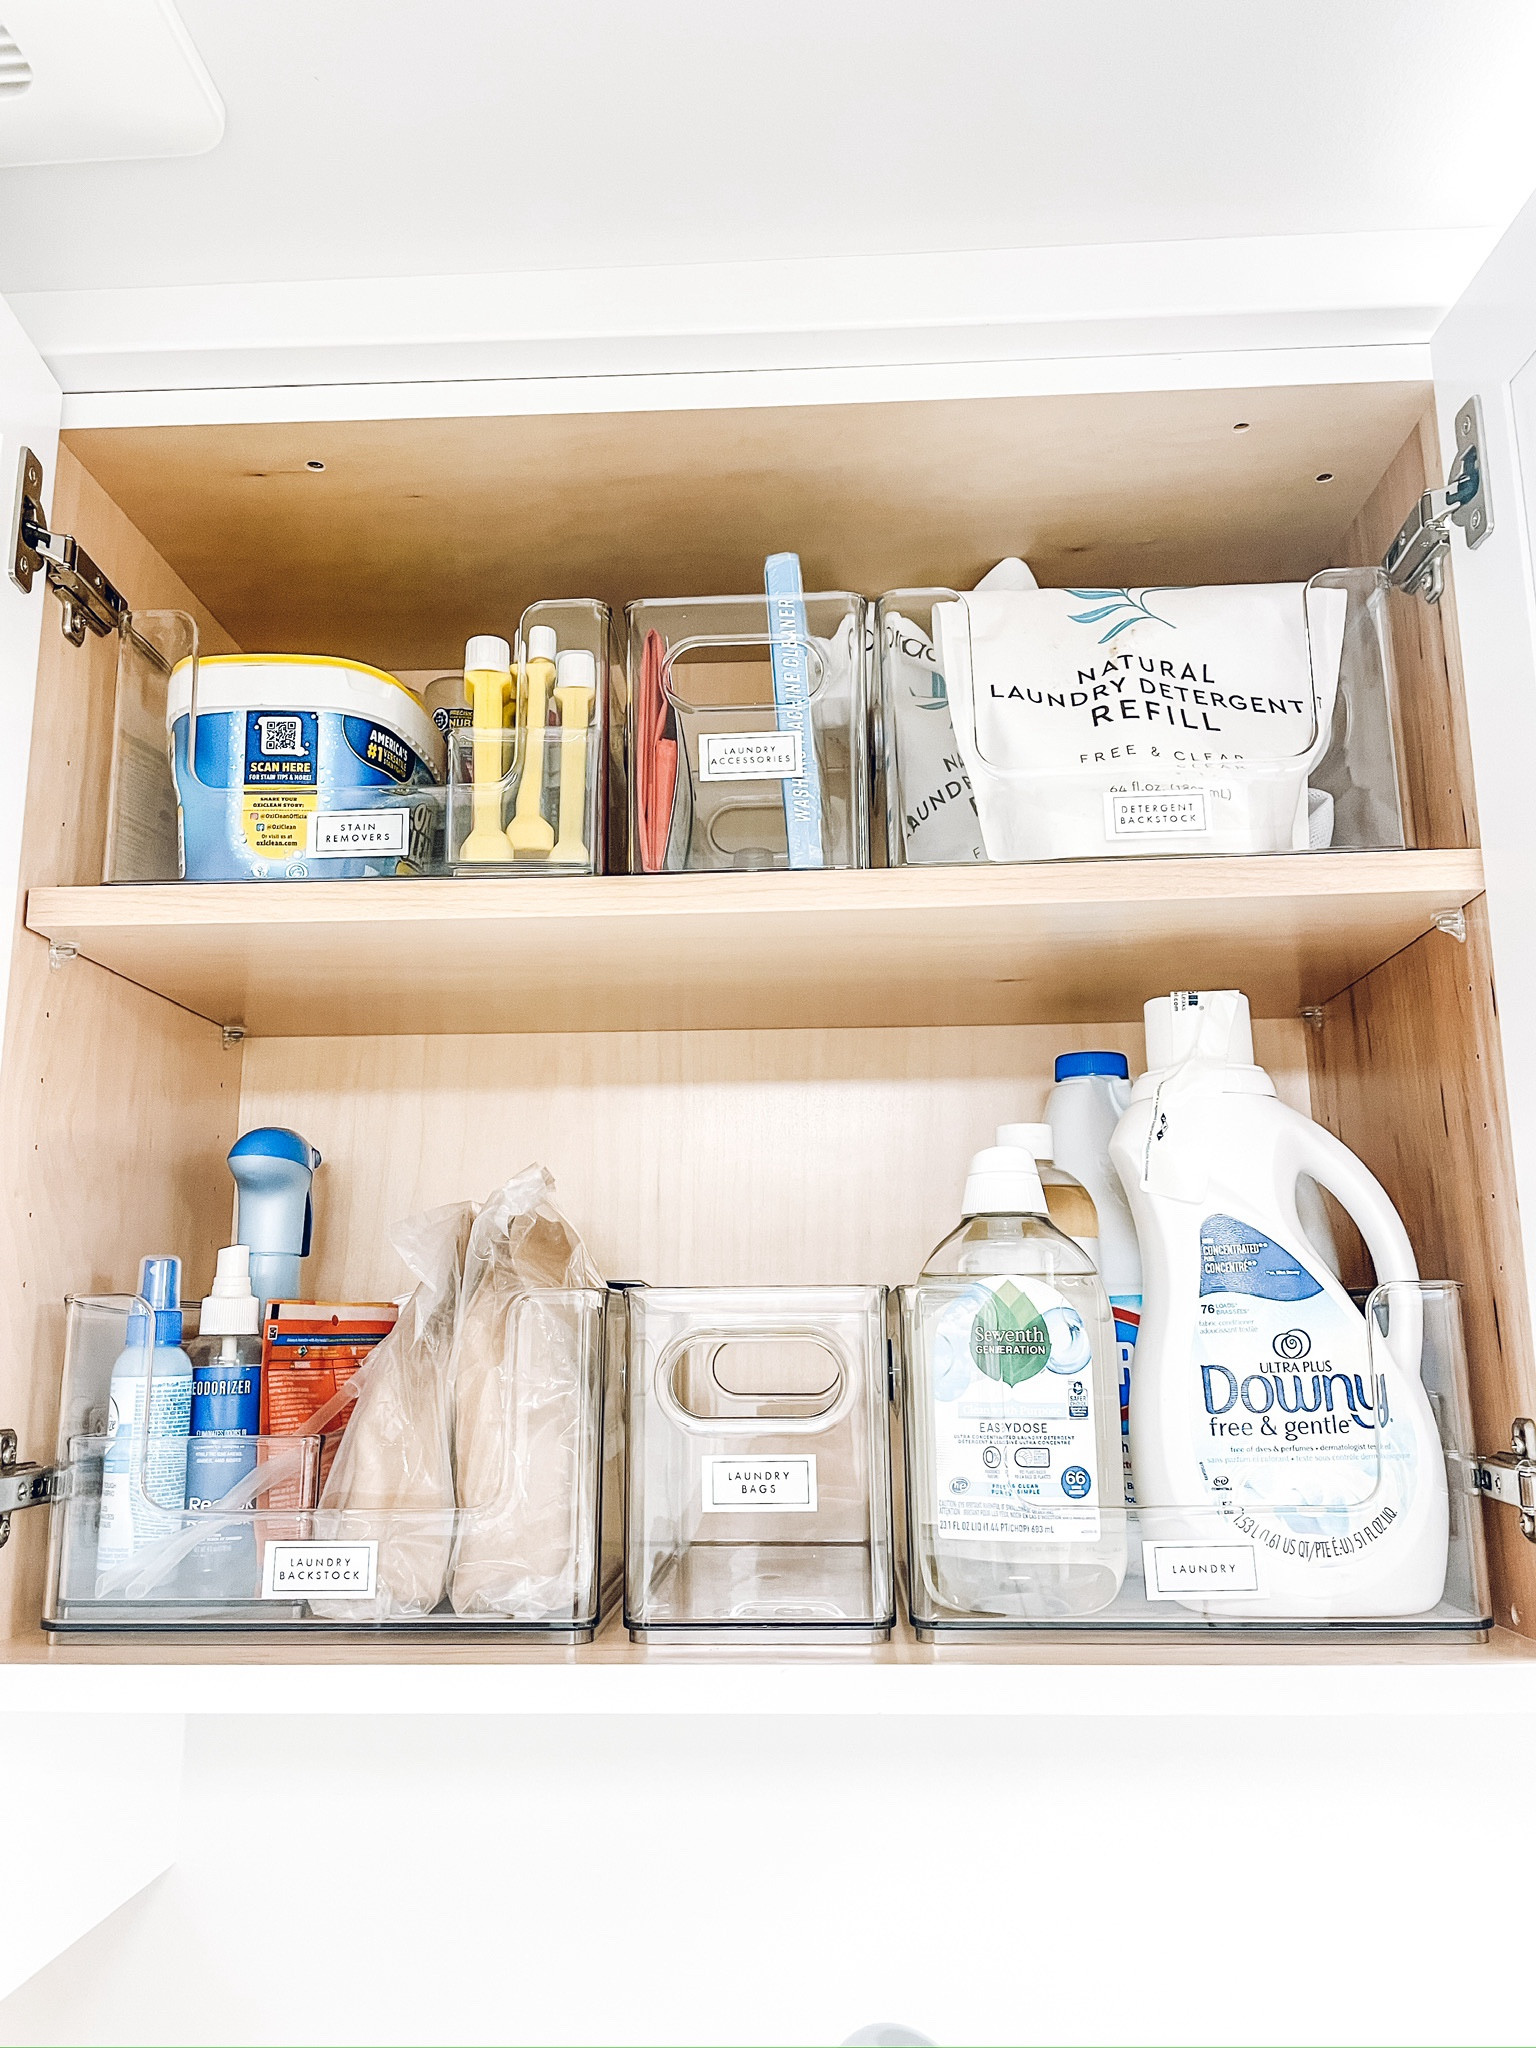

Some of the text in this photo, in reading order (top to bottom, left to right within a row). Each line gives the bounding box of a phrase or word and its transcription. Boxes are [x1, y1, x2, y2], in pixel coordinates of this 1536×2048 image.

[777, 598, 800, 668] CLEANER
[1077, 654, 1215, 685] NATURAL
[990, 676, 1304, 714] LAUNDRY DETERGENT
[783, 673, 806, 738] ACHINE
[1091, 699, 1221, 731] REFILL
[370, 729, 408, 762] AMERICA'S
[725, 745, 776, 755] LAUNDRY
[367, 742, 383, 762] #1
[1080, 744, 1137, 763] FREE
[1151, 746, 1160, 757] &
[711, 755, 791, 765] ACCESSORIES
[250, 762, 311, 772] SCAN HERE
[906, 775, 973, 838] AUNDR
[1121, 802, 1194, 814] DETERGENT
[1120, 813, 1197, 825] BACKSTOCK
[340, 823, 376, 832] STAIN
[325, 833, 390, 843] REMOVERS
[1200, 1304, 1215, 1314] 76
[975, 1326, 1045, 1343] Seventh
[975, 1345, 1046, 1355] GENERATION
[1259, 1360, 1333, 1374] ULTRA PLUS
[192, 1380, 251, 1396] EODORIZER
[979, 1422, 1048, 1434] EASYDOSE
[1209, 1414, 1350, 1442] free & gentle
[1280, 1445, 1314, 1454] perfumes
[1319, 1443, 1366, 1452] dermatologist
[728, 1471, 790, 1481] LAUNDRY
[1065, 1471, 1087, 1485] 66
[741, 1484, 776, 1494] BAGS
[952, 1520, 960, 1531] FL
[962, 1521, 970, 1531] OZ
[1233, 1513, 1255, 1534] 1.53
[1251, 1524, 1259, 1539] L
[1282, 1539, 1296, 1555] US
[1298, 1540, 1332, 1562] QT/PTE
[1353, 1531, 1368, 1549] 51
[1364, 1526, 1375, 1541] FL
[1371, 1516, 1385, 1535] OZ
[290, 1557, 351, 1567] LAUNDRY
[1172, 1564, 1236, 1574] LAUNDRY
[279, 1571, 360, 1580] BACKSTOCK
